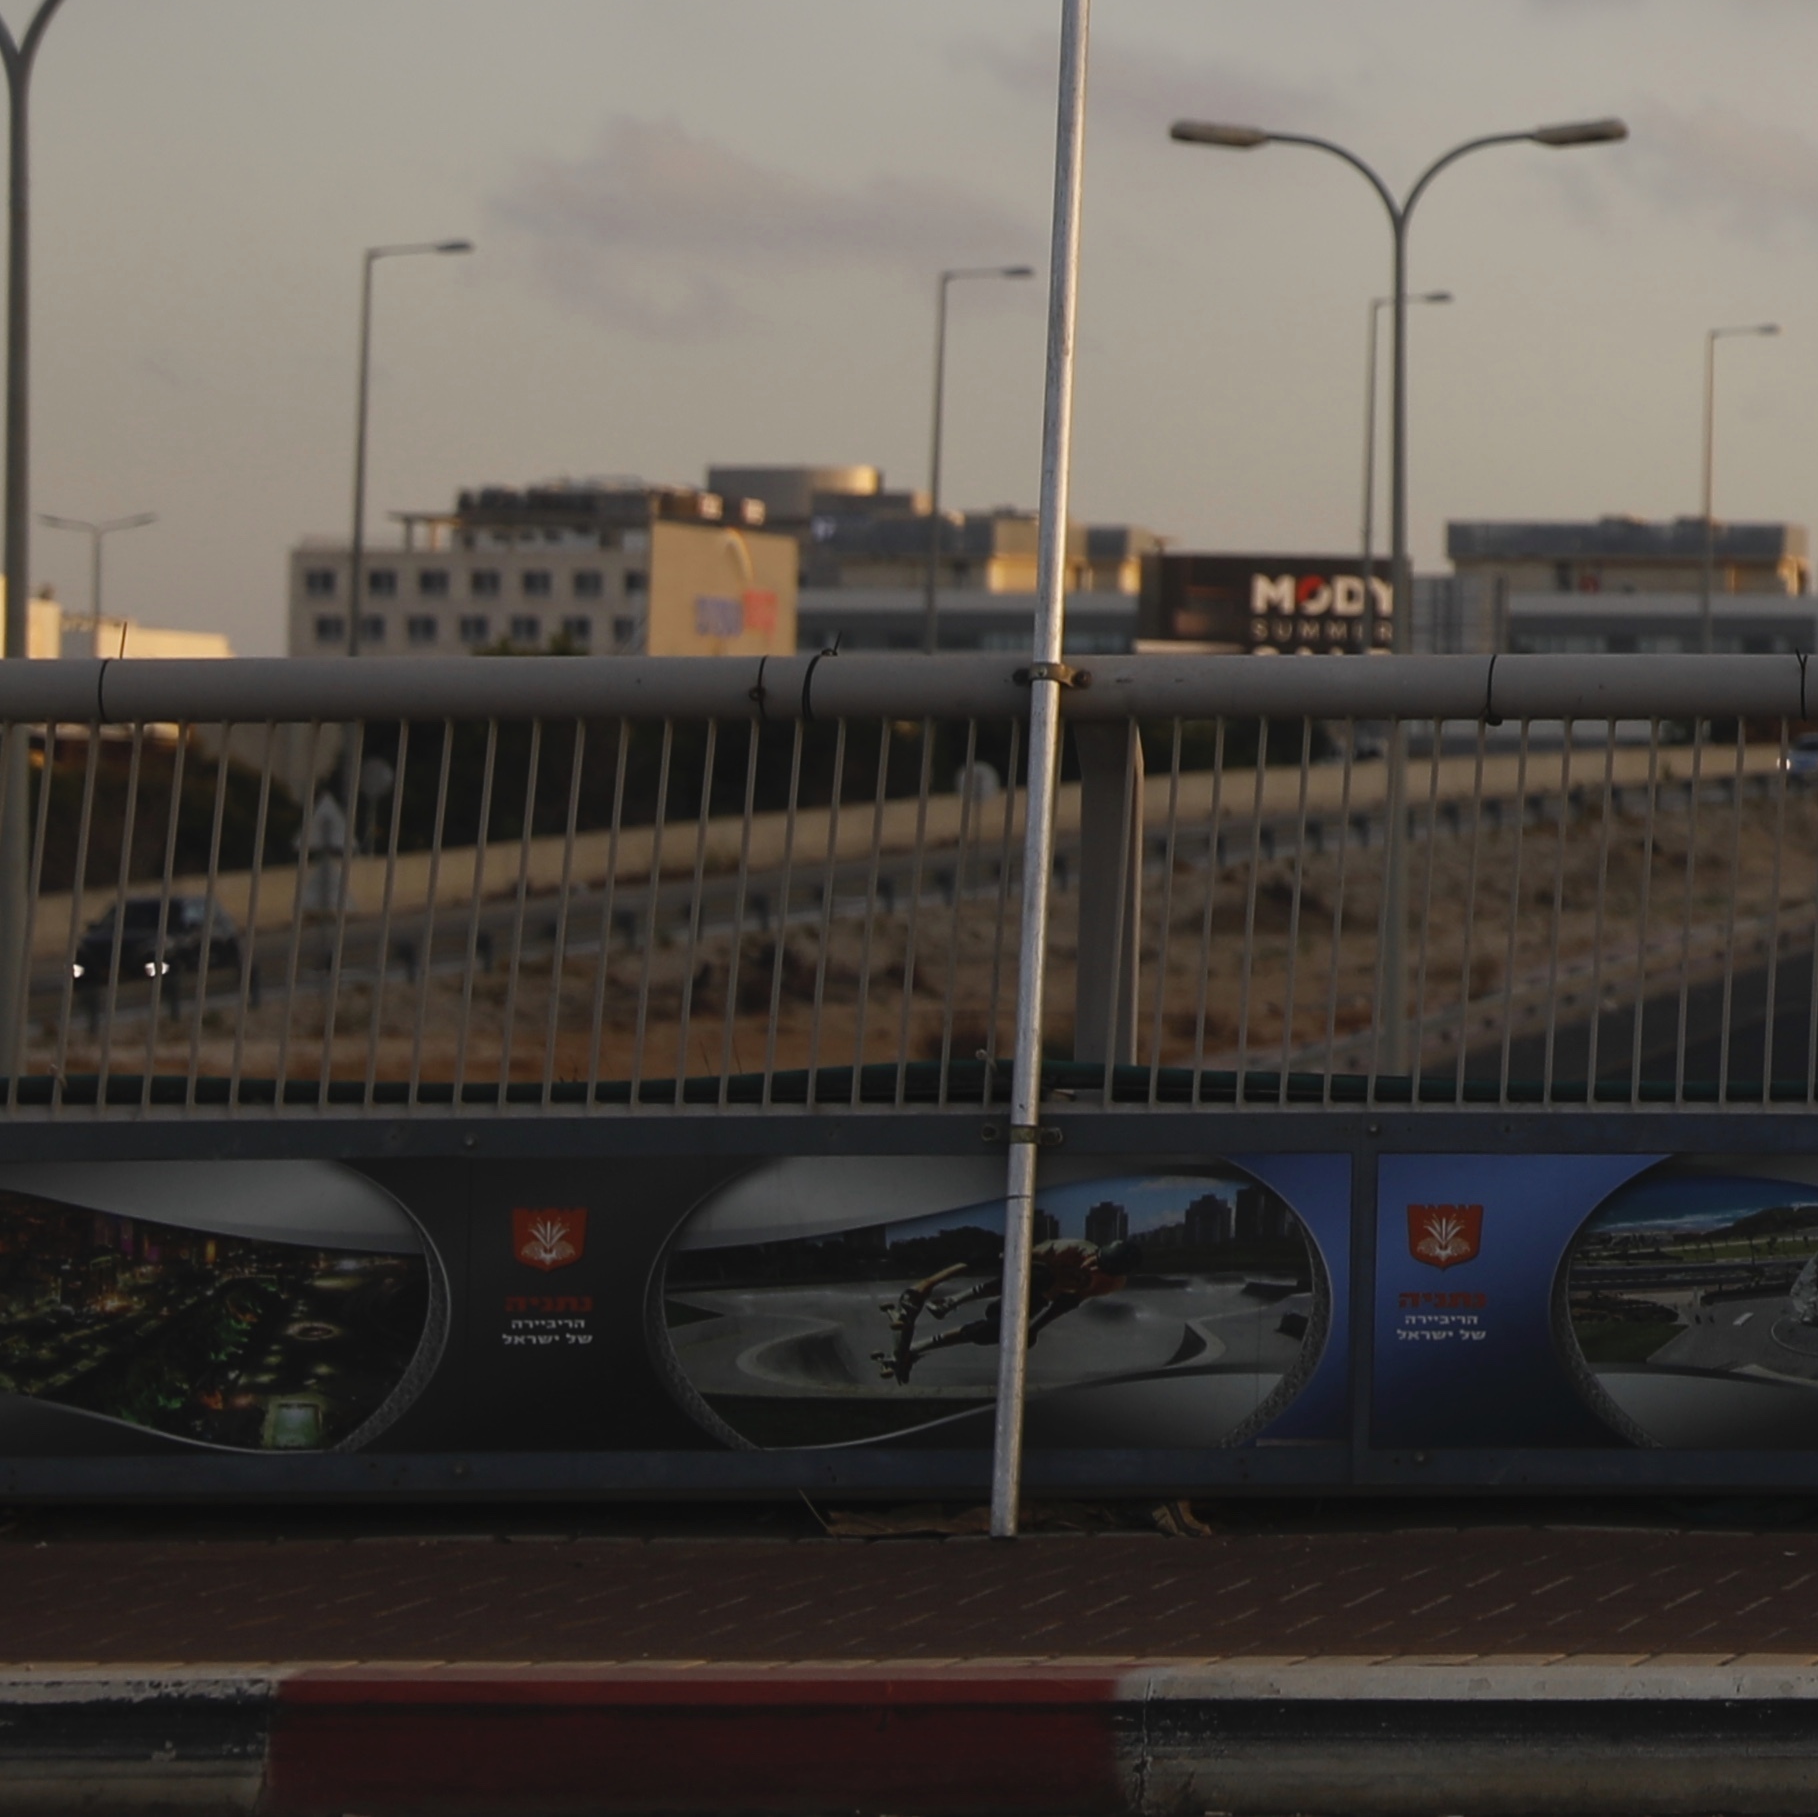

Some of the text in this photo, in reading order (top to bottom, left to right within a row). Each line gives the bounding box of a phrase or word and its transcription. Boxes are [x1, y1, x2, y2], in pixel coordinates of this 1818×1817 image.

[1252, 573, 1394, 617] MODY
[505, 1295, 593, 1312] נתניה
[1399, 1292, 1488, 1309] נתניה
[511, 1319, 585, 1329] הריביירה
[1405, 1314, 1478, 1325] הריביירה
[502, 1333, 593, 1345] של ישראל
[1397, 1329, 1486, 1340] של ישראל
